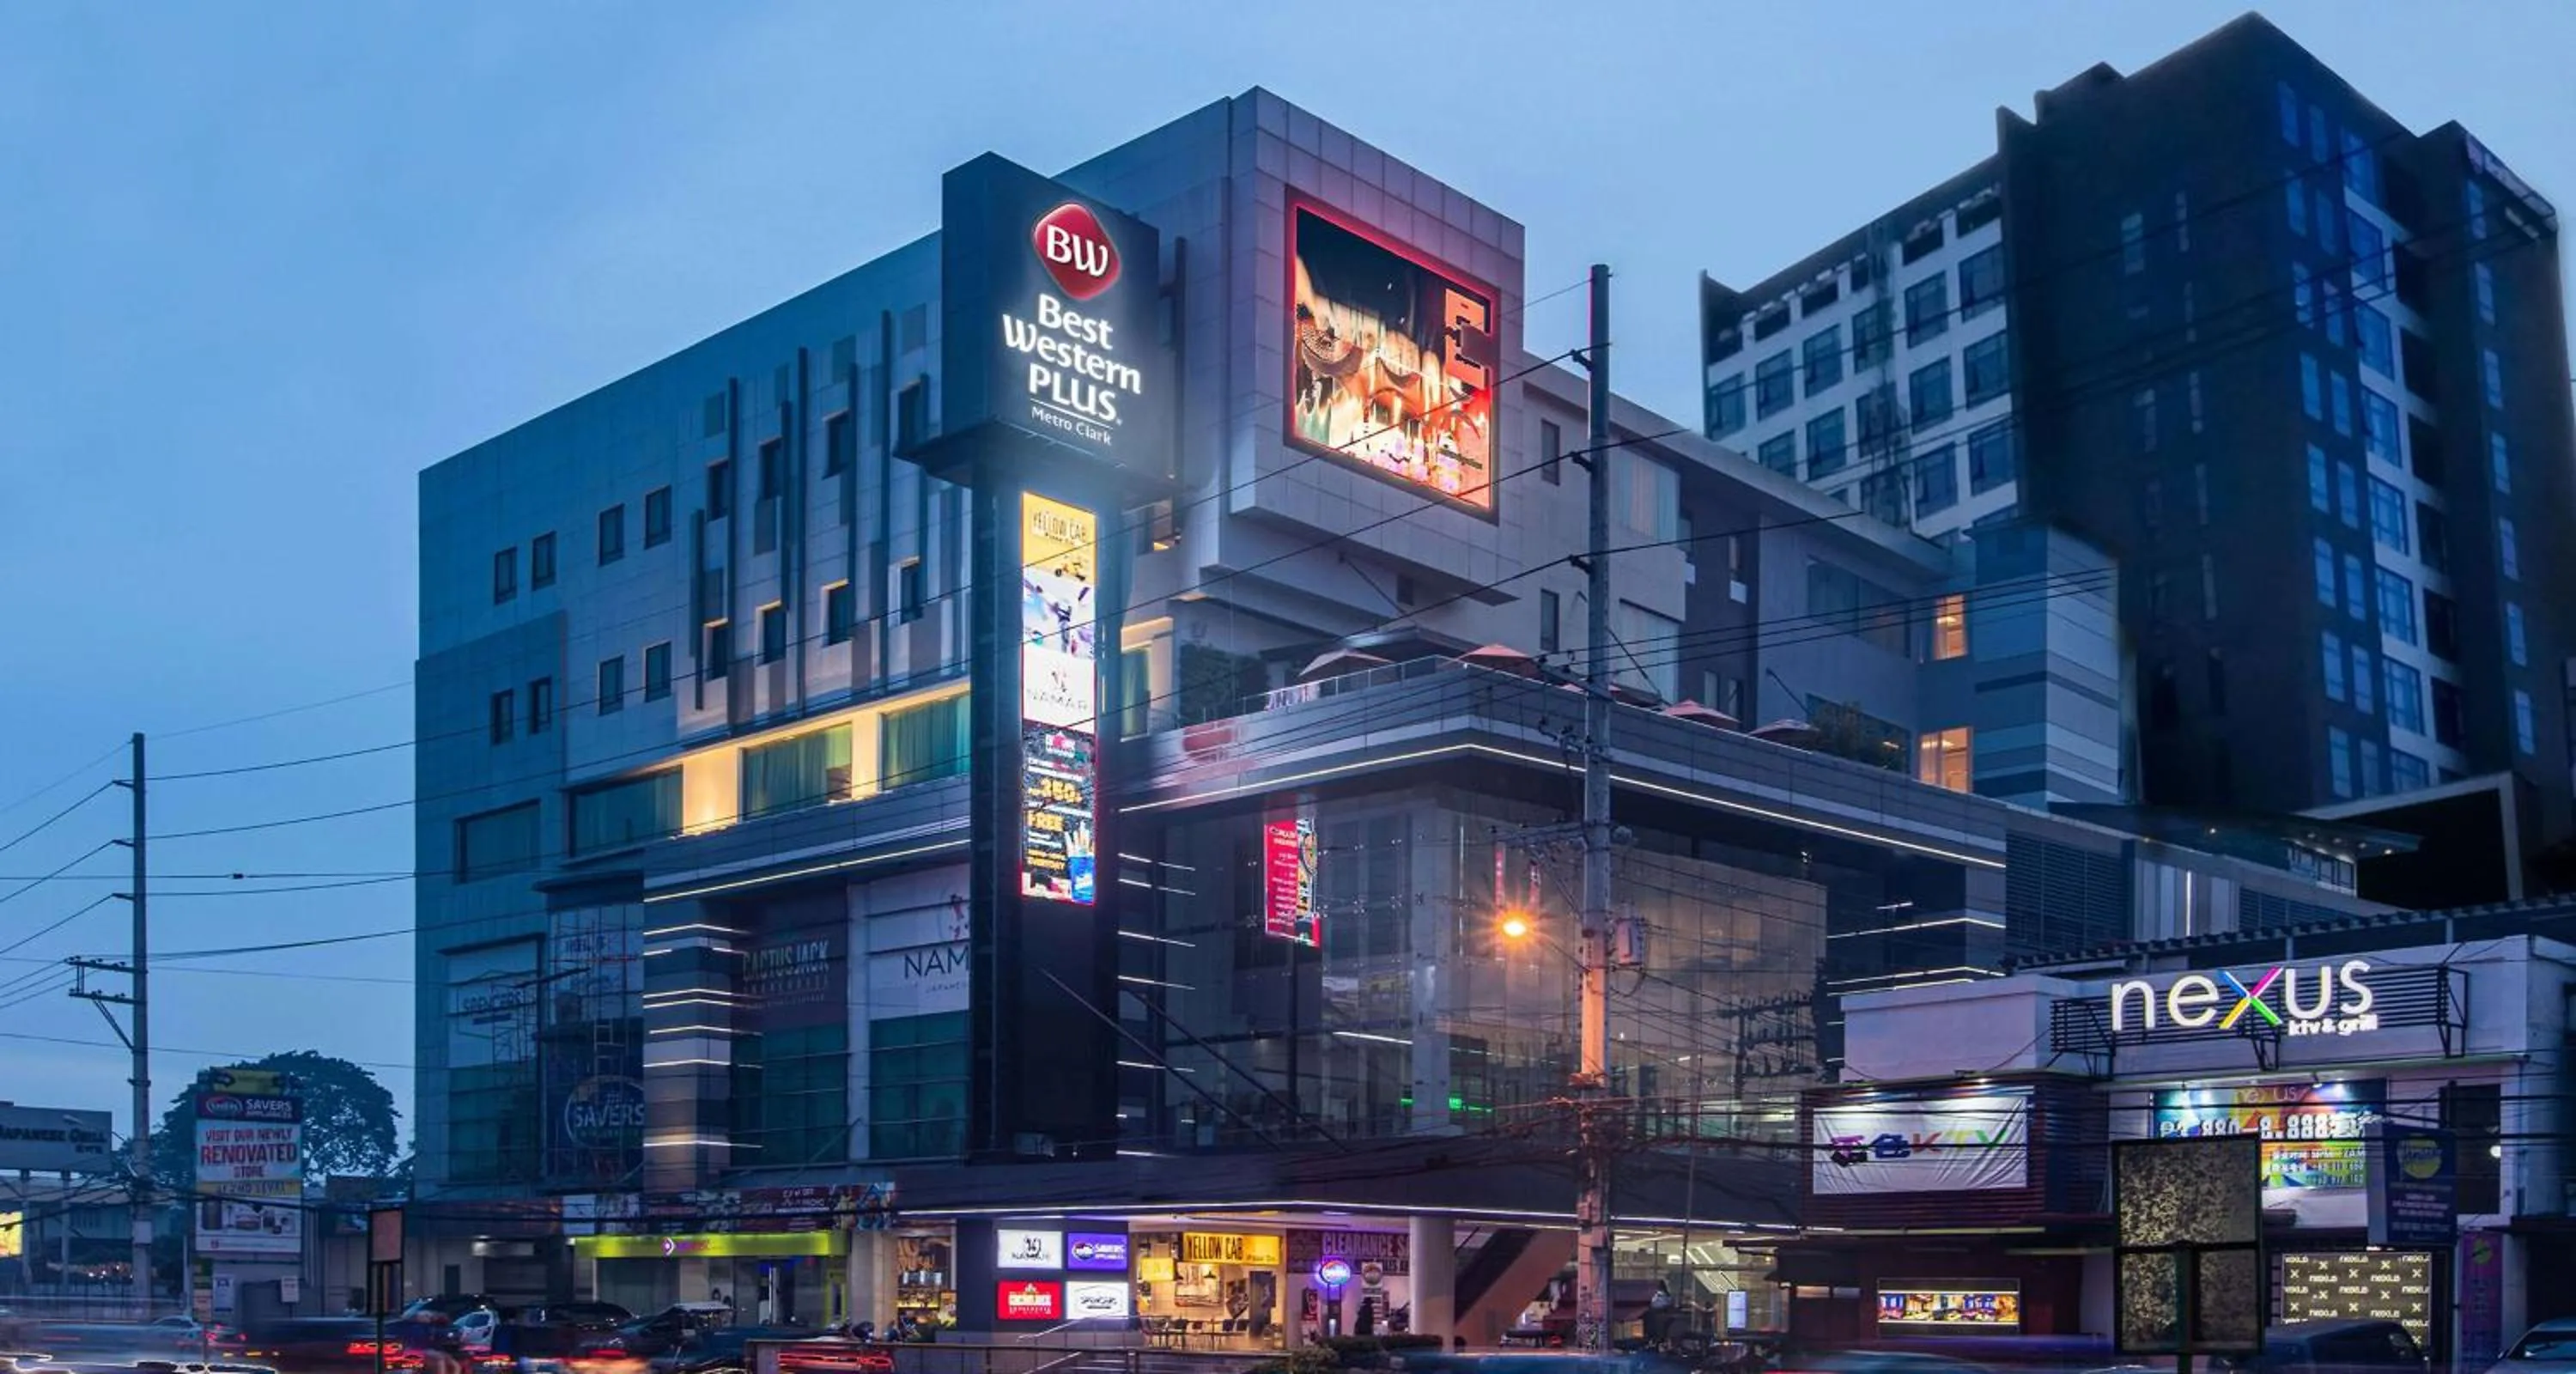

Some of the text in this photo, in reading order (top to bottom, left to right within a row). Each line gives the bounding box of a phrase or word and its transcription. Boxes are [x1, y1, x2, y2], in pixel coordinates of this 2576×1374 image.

[1047, 224, 1109, 277] BW
[1037, 293, 1114, 350] Best
[1002, 313, 1141, 394] Western
[1030, 405, 1113, 447] Metro Clark
[246, 1098, 292, 1112] SAVERS
[574, 1103, 644, 1127] SAVERS
[1912, 1129, 2008, 1153] KTV
[200, 1143, 298, 1165] RENOVATED
[1186, 1235, 1243, 1261] YELLOW CAB
[1322, 1231, 1394, 1256] CLEARANCE
